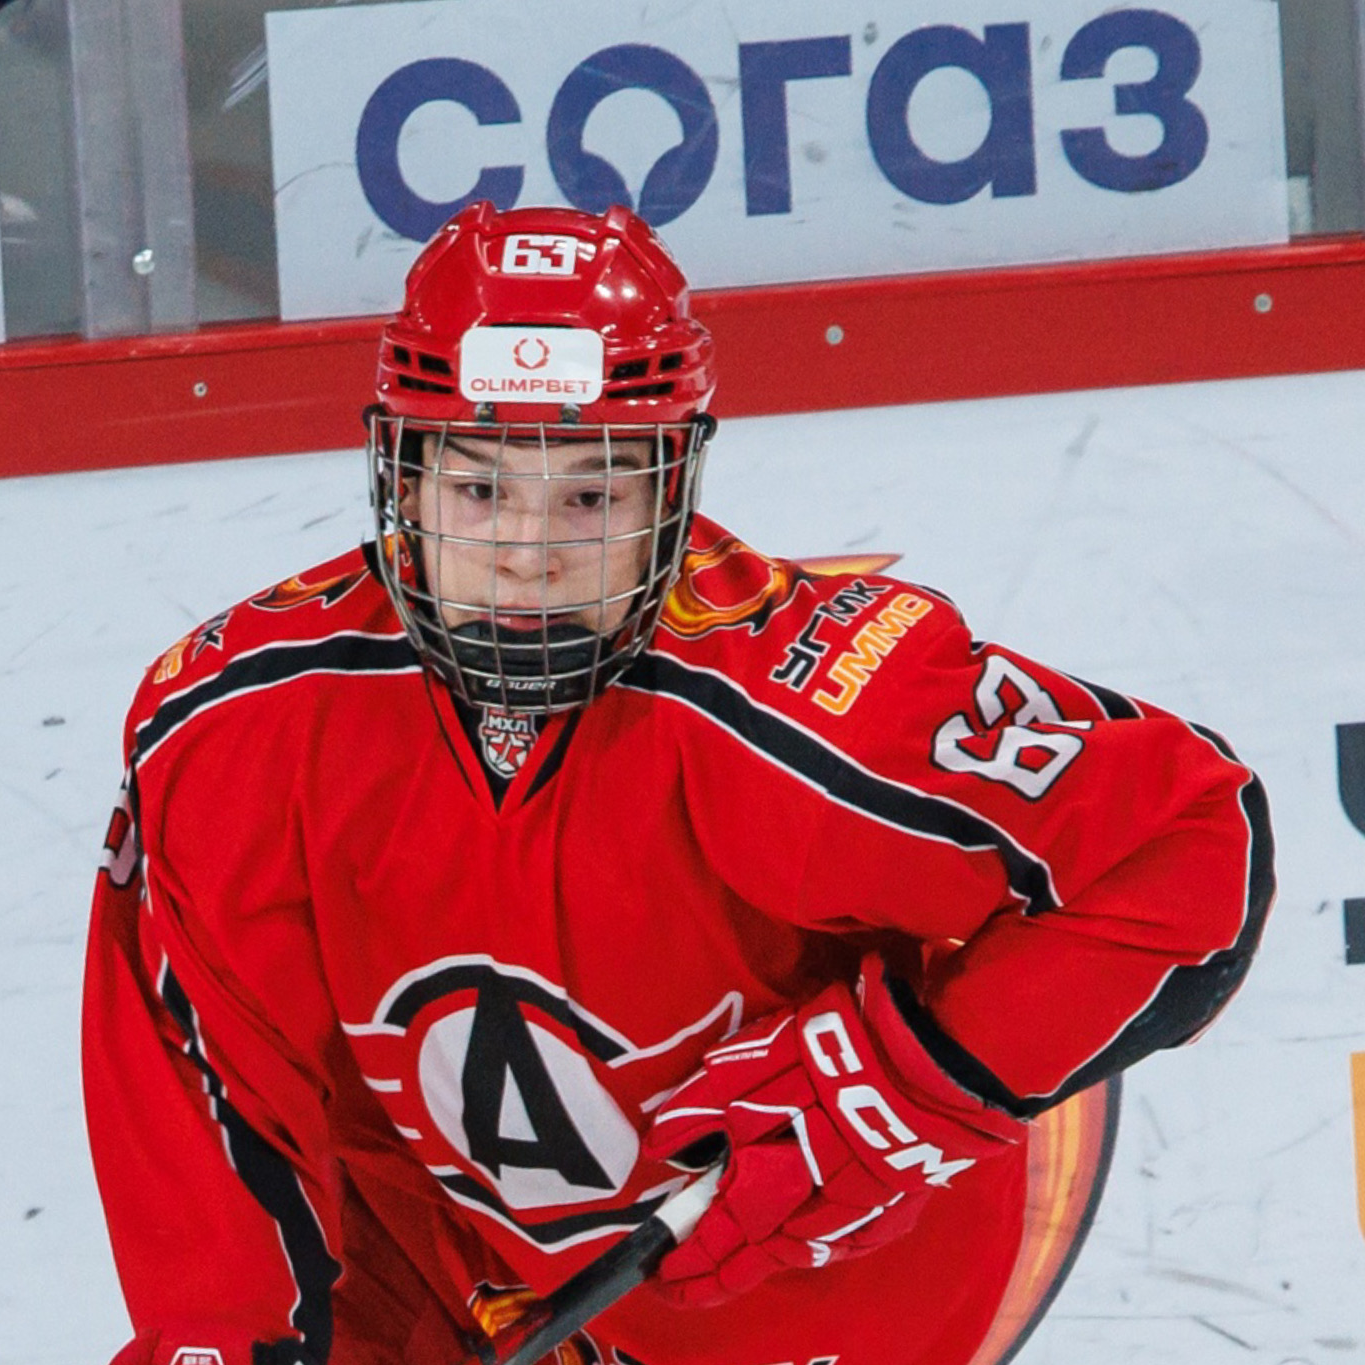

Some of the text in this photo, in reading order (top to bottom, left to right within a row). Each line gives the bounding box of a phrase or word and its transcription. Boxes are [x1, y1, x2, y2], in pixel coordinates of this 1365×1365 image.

[501, 233, 579, 275] 63
[470, 377, 592, 395] OLIMPBET
[769, 578, 895, 692] УГМК
[812, 592, 934, 717] UMMC
[489, 715, 529, 733] МХЛ
[802, 1011, 975, 1186] CCM
